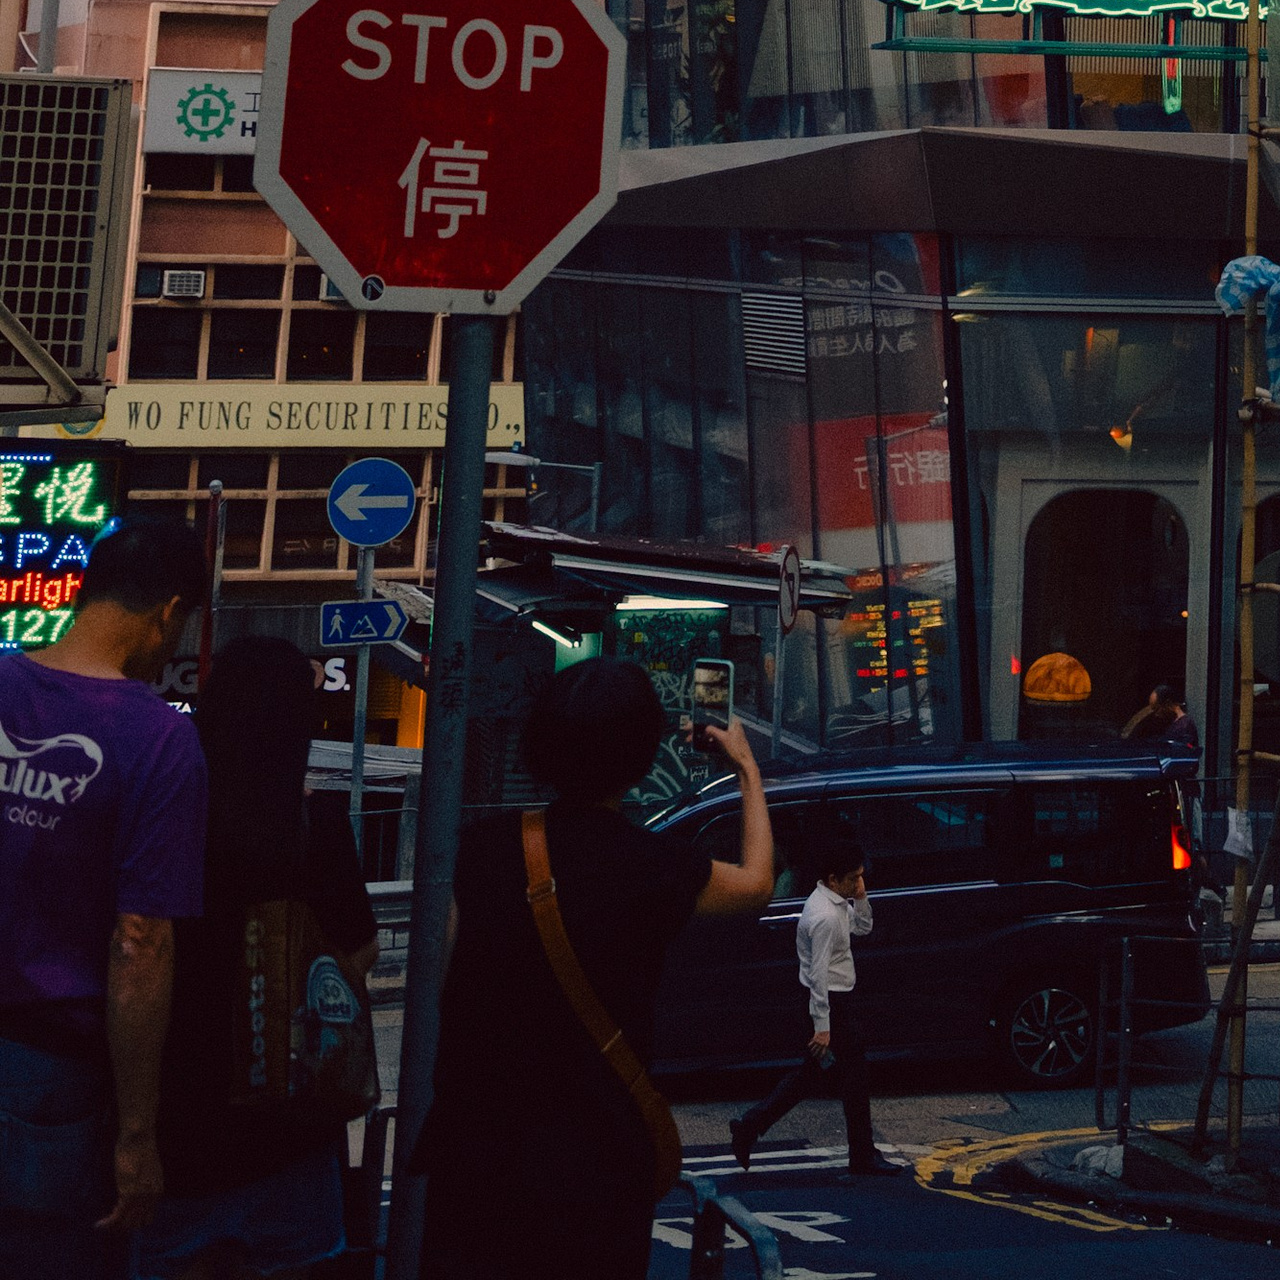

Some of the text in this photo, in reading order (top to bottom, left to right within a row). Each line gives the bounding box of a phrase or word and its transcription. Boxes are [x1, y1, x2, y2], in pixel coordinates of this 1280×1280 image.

[340, 8, 565, 93] STOP
[396, 136, 489, 240] 停
[127, 401, 521, 434] WO FUNG SECURITIES O.,
[0, 532, 88, 569] PA
[0, 758, 73, 806] ulux
[8, 804, 61, 831] olour
